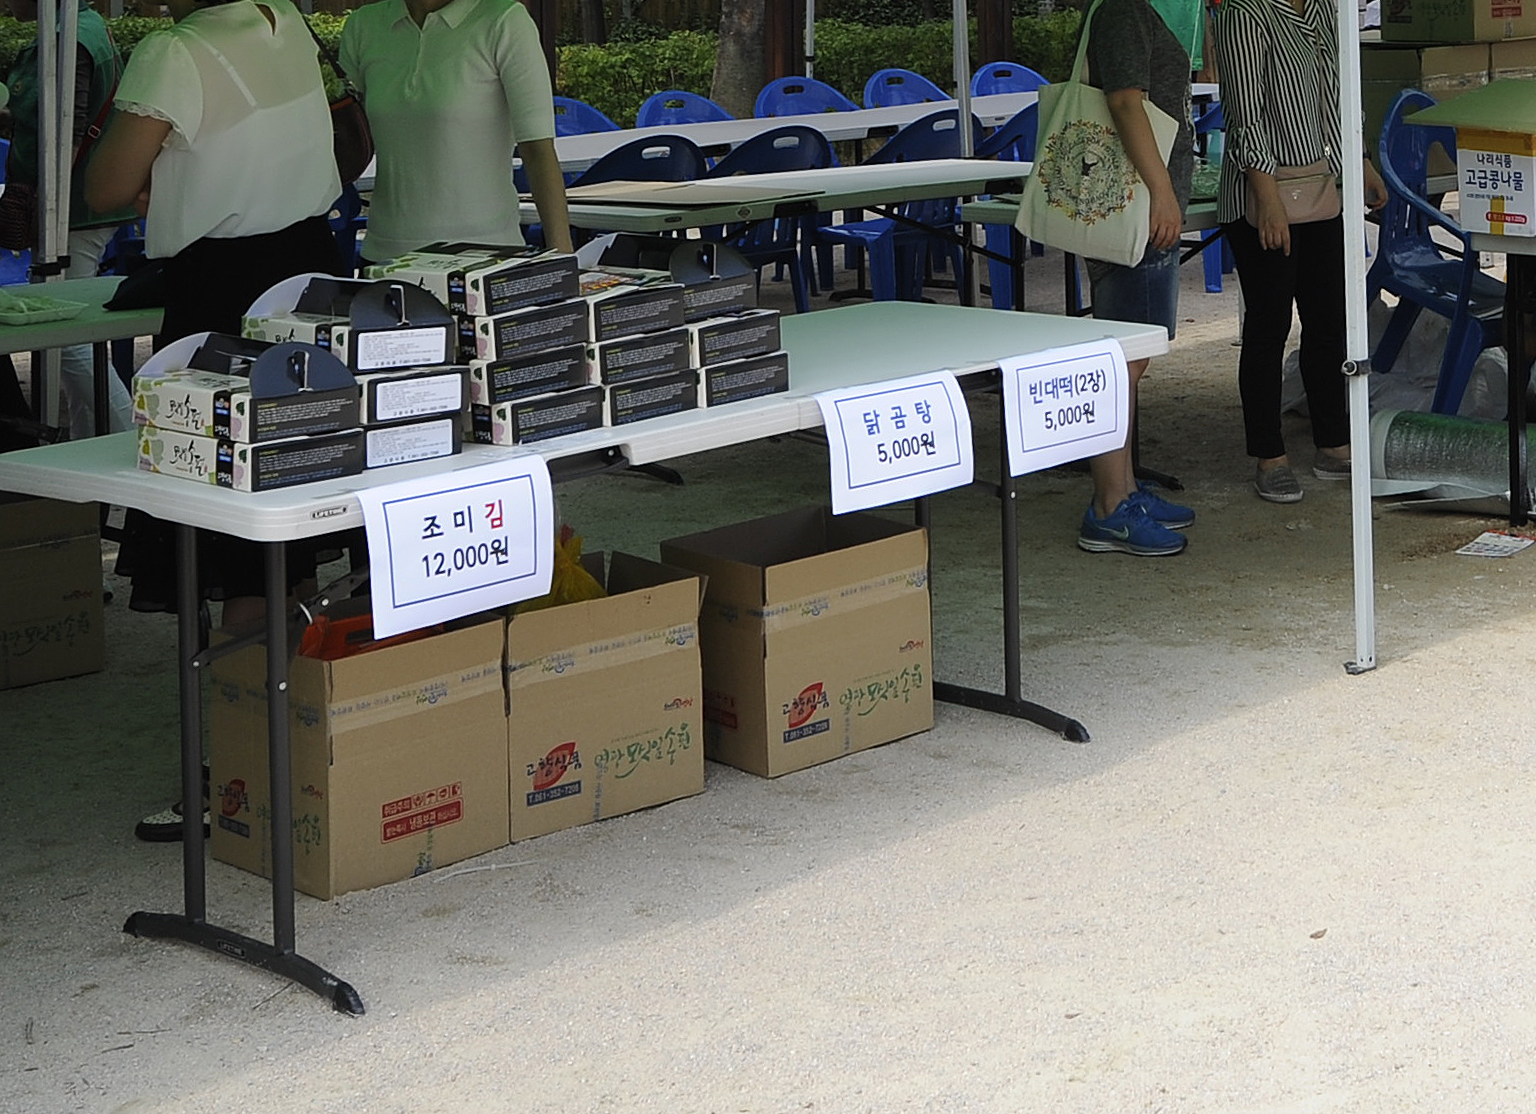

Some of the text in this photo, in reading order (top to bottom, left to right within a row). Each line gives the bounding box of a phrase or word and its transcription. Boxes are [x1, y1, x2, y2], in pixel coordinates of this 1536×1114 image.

[1476, 153, 1512, 168] 나리식품
[1465, 169, 1524, 191] 고급콩나물
[1029, 368, 1107, 404] 빈대떡(2장)
[1044, 400, 1095, 431] 5,000원
[877, 430, 936, 464] 5,000원
[422, 536, 509, 578] 12,000원
